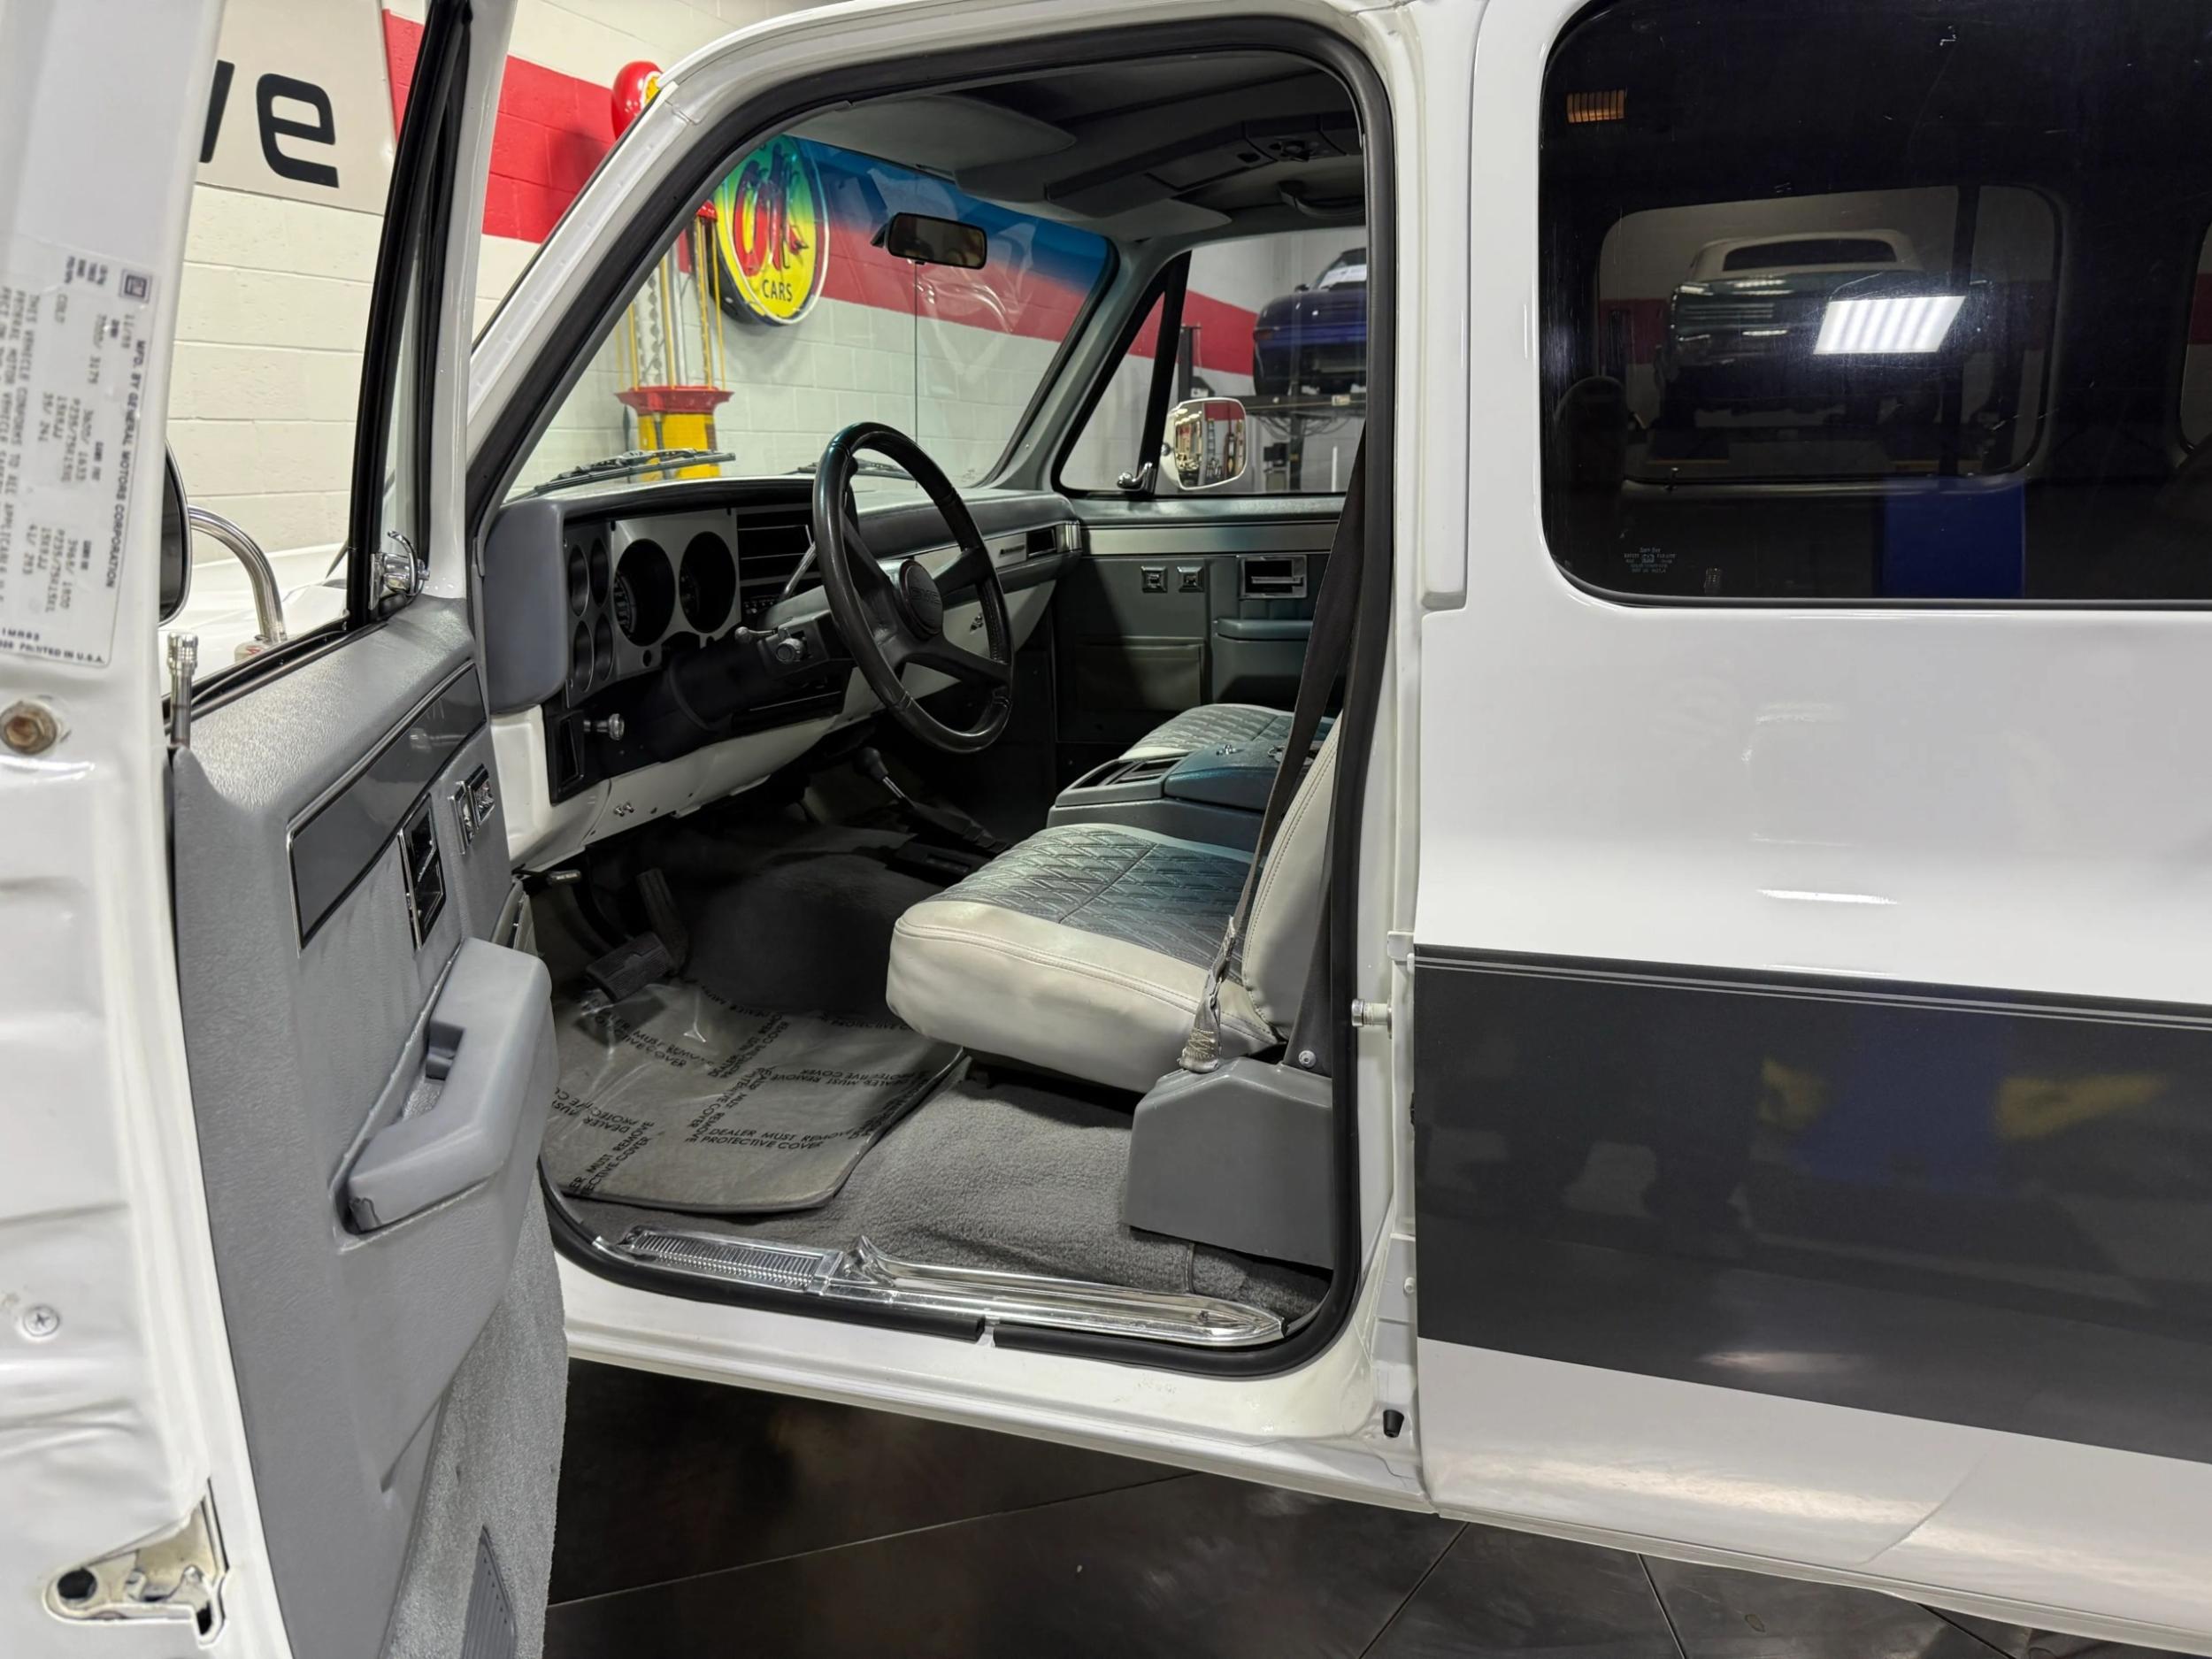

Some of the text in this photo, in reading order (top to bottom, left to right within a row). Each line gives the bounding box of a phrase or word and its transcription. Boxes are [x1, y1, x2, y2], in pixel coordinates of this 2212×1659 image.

[761, 279, 794, 302] CARS
[130, 373, 142, 390] BY
[122, 392, 138, 446] GENERAL
[116, 450, 131, 501] MOTORS
[105, 503, 126, 588] CORPORATION
[63, 649, 74, 659] IN
[582, 1116, 630, 1133] DEALER
[701, 1135, 776, 1148] PROTECTIVE
[709, 1128, 757, 1138] DEALER
[761, 1132, 796, 1141] MUST
